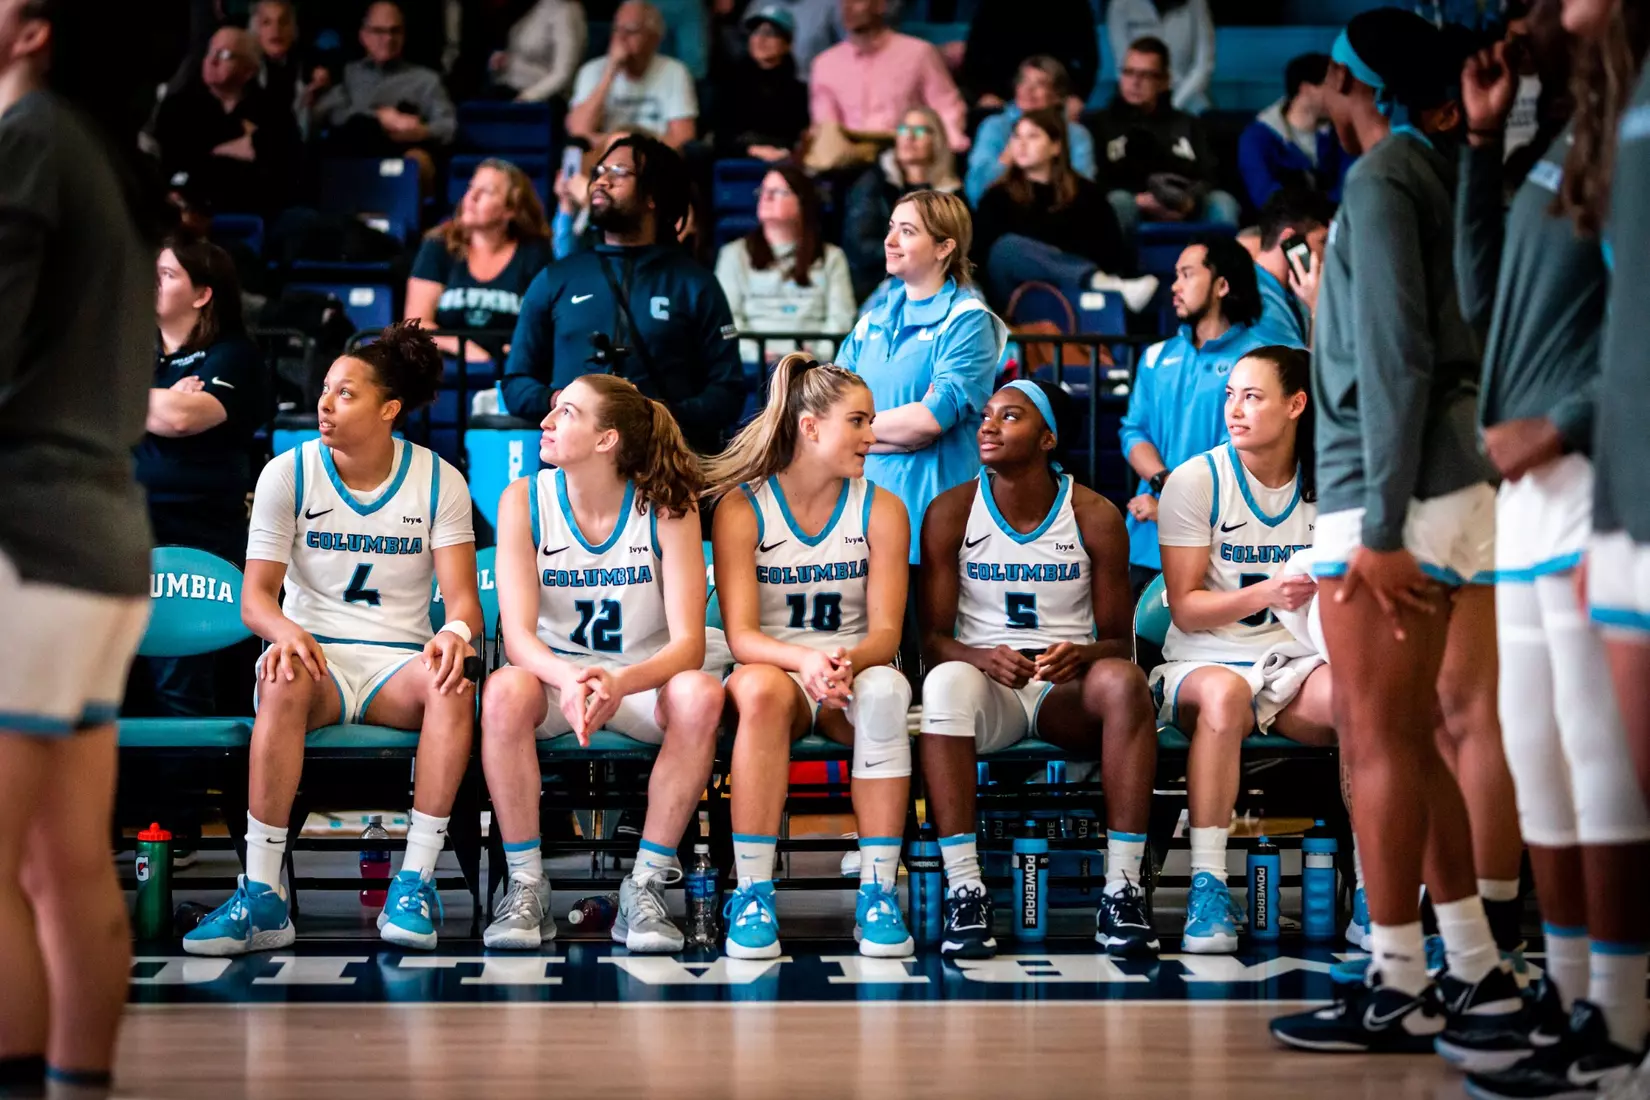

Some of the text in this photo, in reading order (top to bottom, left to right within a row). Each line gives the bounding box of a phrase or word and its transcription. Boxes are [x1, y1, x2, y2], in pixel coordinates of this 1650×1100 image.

[650, 296, 670, 321] C
[403, 516, 416, 525] Ivy
[306, 531, 423, 555] COLUMBIA
[629, 546, 643, 555] Ivy
[844, 536, 858, 545] Ivy
[1055, 543, 1069, 552] Ivy
[1220, 542, 1313, 564] COLUM
[542, 565, 652, 588] COLUMBIA
[756, 558, 869, 585] COLUMBIA
[966, 562, 1081, 582] COLUMBIA
[149, 572, 234, 603] UMBIA
[343, 563, 382, 607] 4
[1005, 592, 1039, 630] 5
[569, 598, 623, 654] 12
[1025, 855, 1036, 925] POWERADE
[1257, 867, 1266, 928] POWERADE
